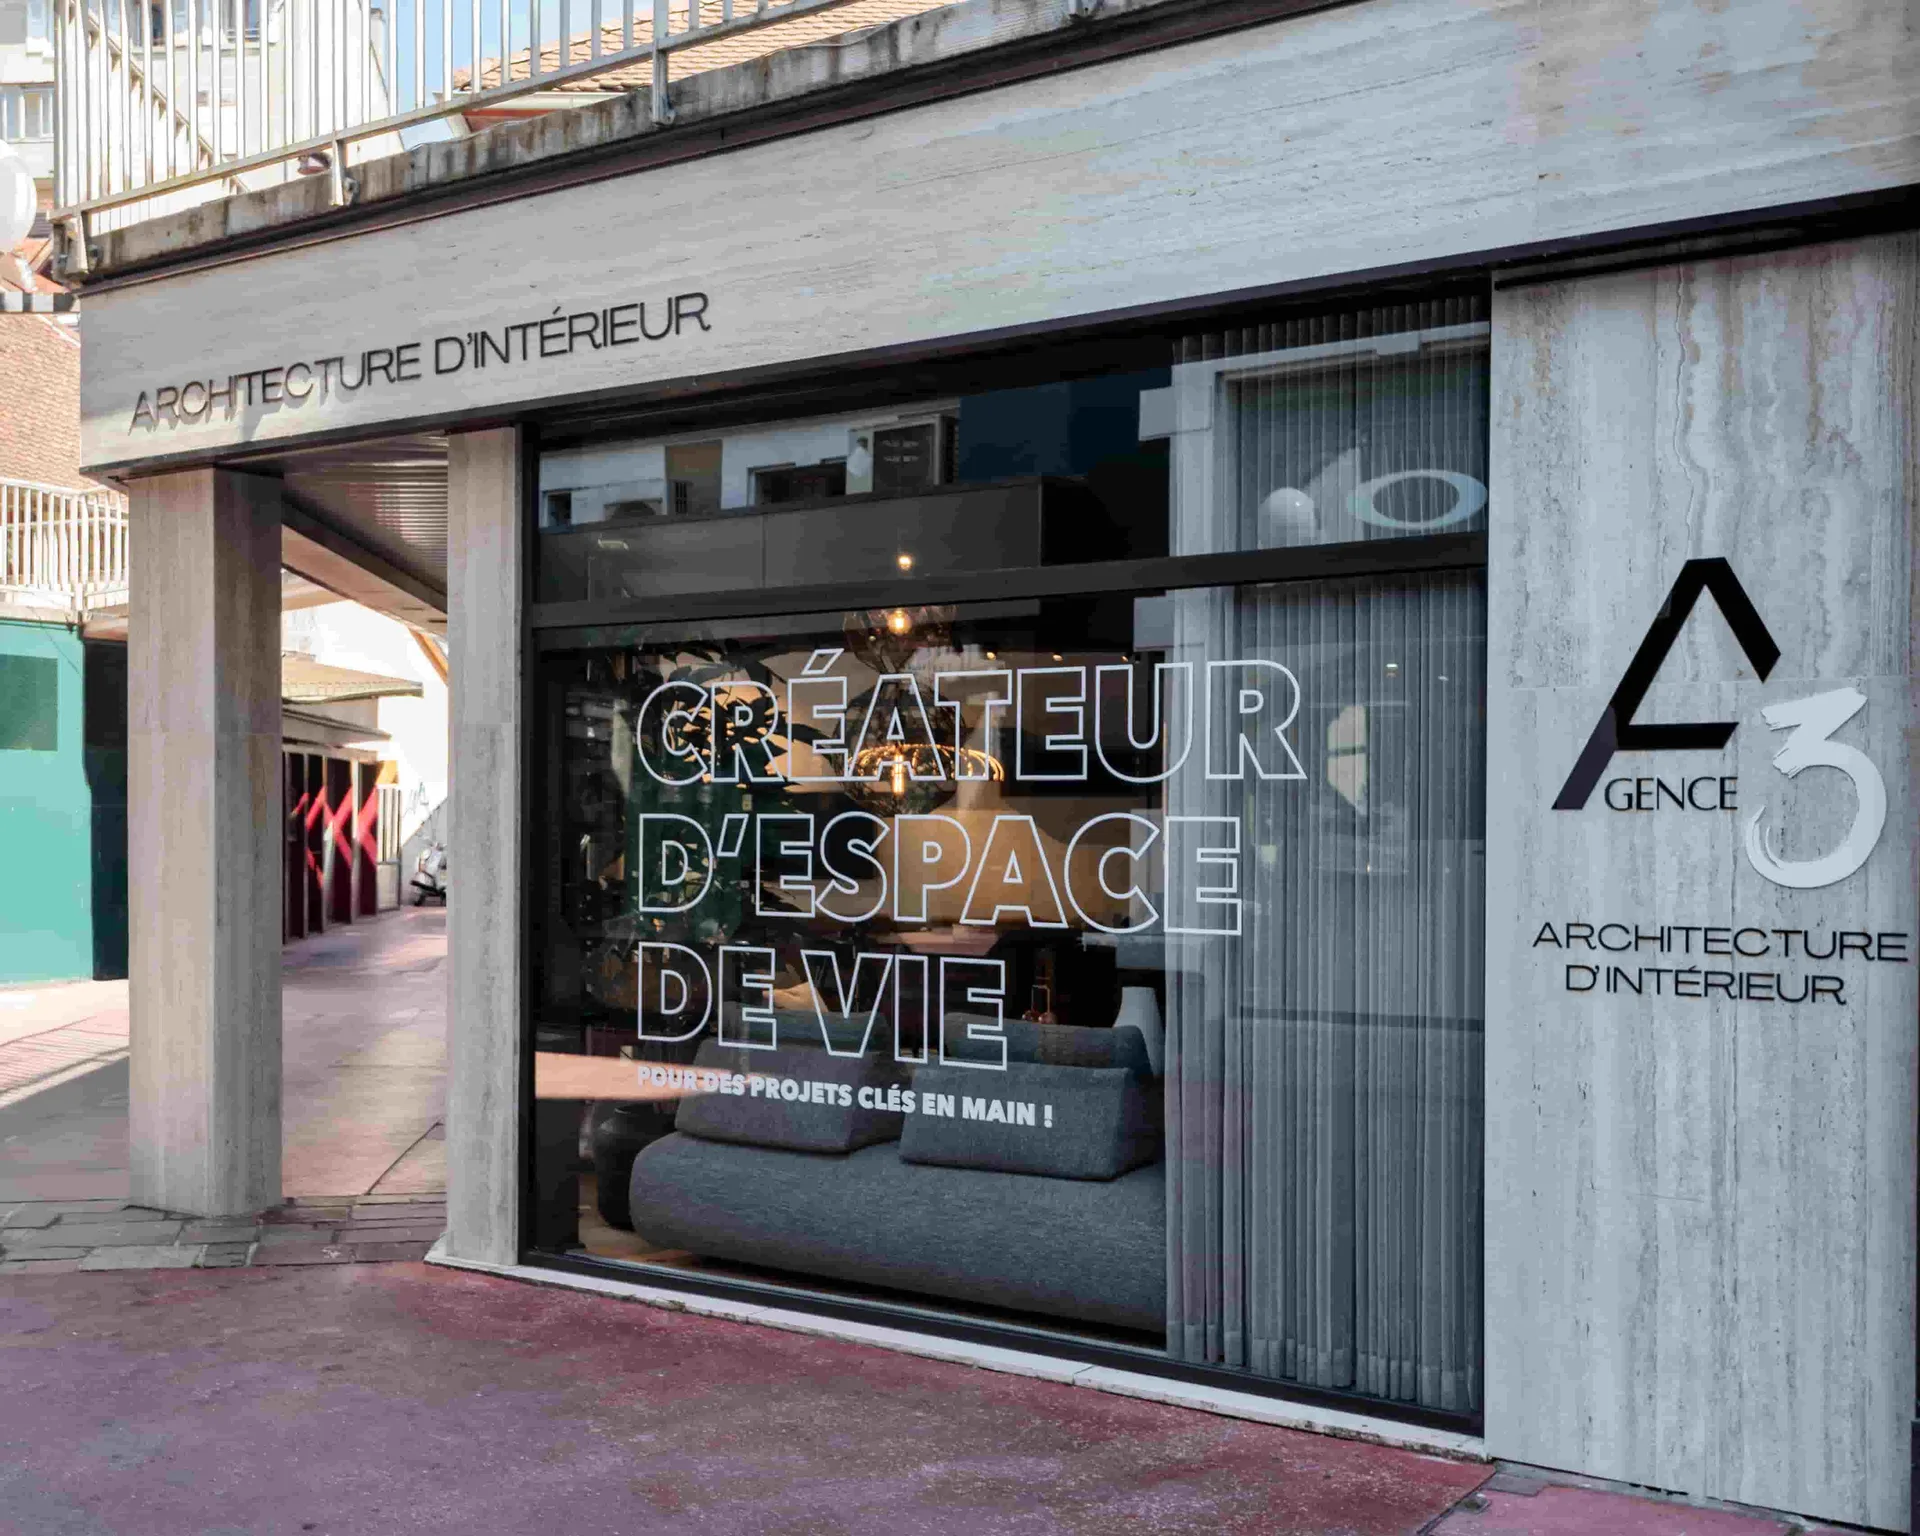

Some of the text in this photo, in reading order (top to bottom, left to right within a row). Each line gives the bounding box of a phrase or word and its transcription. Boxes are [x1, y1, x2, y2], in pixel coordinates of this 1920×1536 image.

[128, 292, 711, 436] ARCHITECTURE D'INTÉRIEUR
[636, 648, 1307, 785] CRÉATEUR
[1745, 687, 1887, 889] 3
[637, 813, 1243, 937] D'ESPACE
[1532, 921, 1909, 963] ARCHITECTURE
[1565, 965, 1847, 1006] D'INTÉRIEUR
[636, 941, 1008, 1071] DE VIE
[637, 1066, 698, 1090] POUR
[703, 1073, 746, 1096] DES
[750, 1076, 853, 1107] PROJETS
[857, 1083, 916, 1114] CLÉS
[922, 1092, 955, 1118] EN
[961, 1096, 1036, 1127] MAIN
